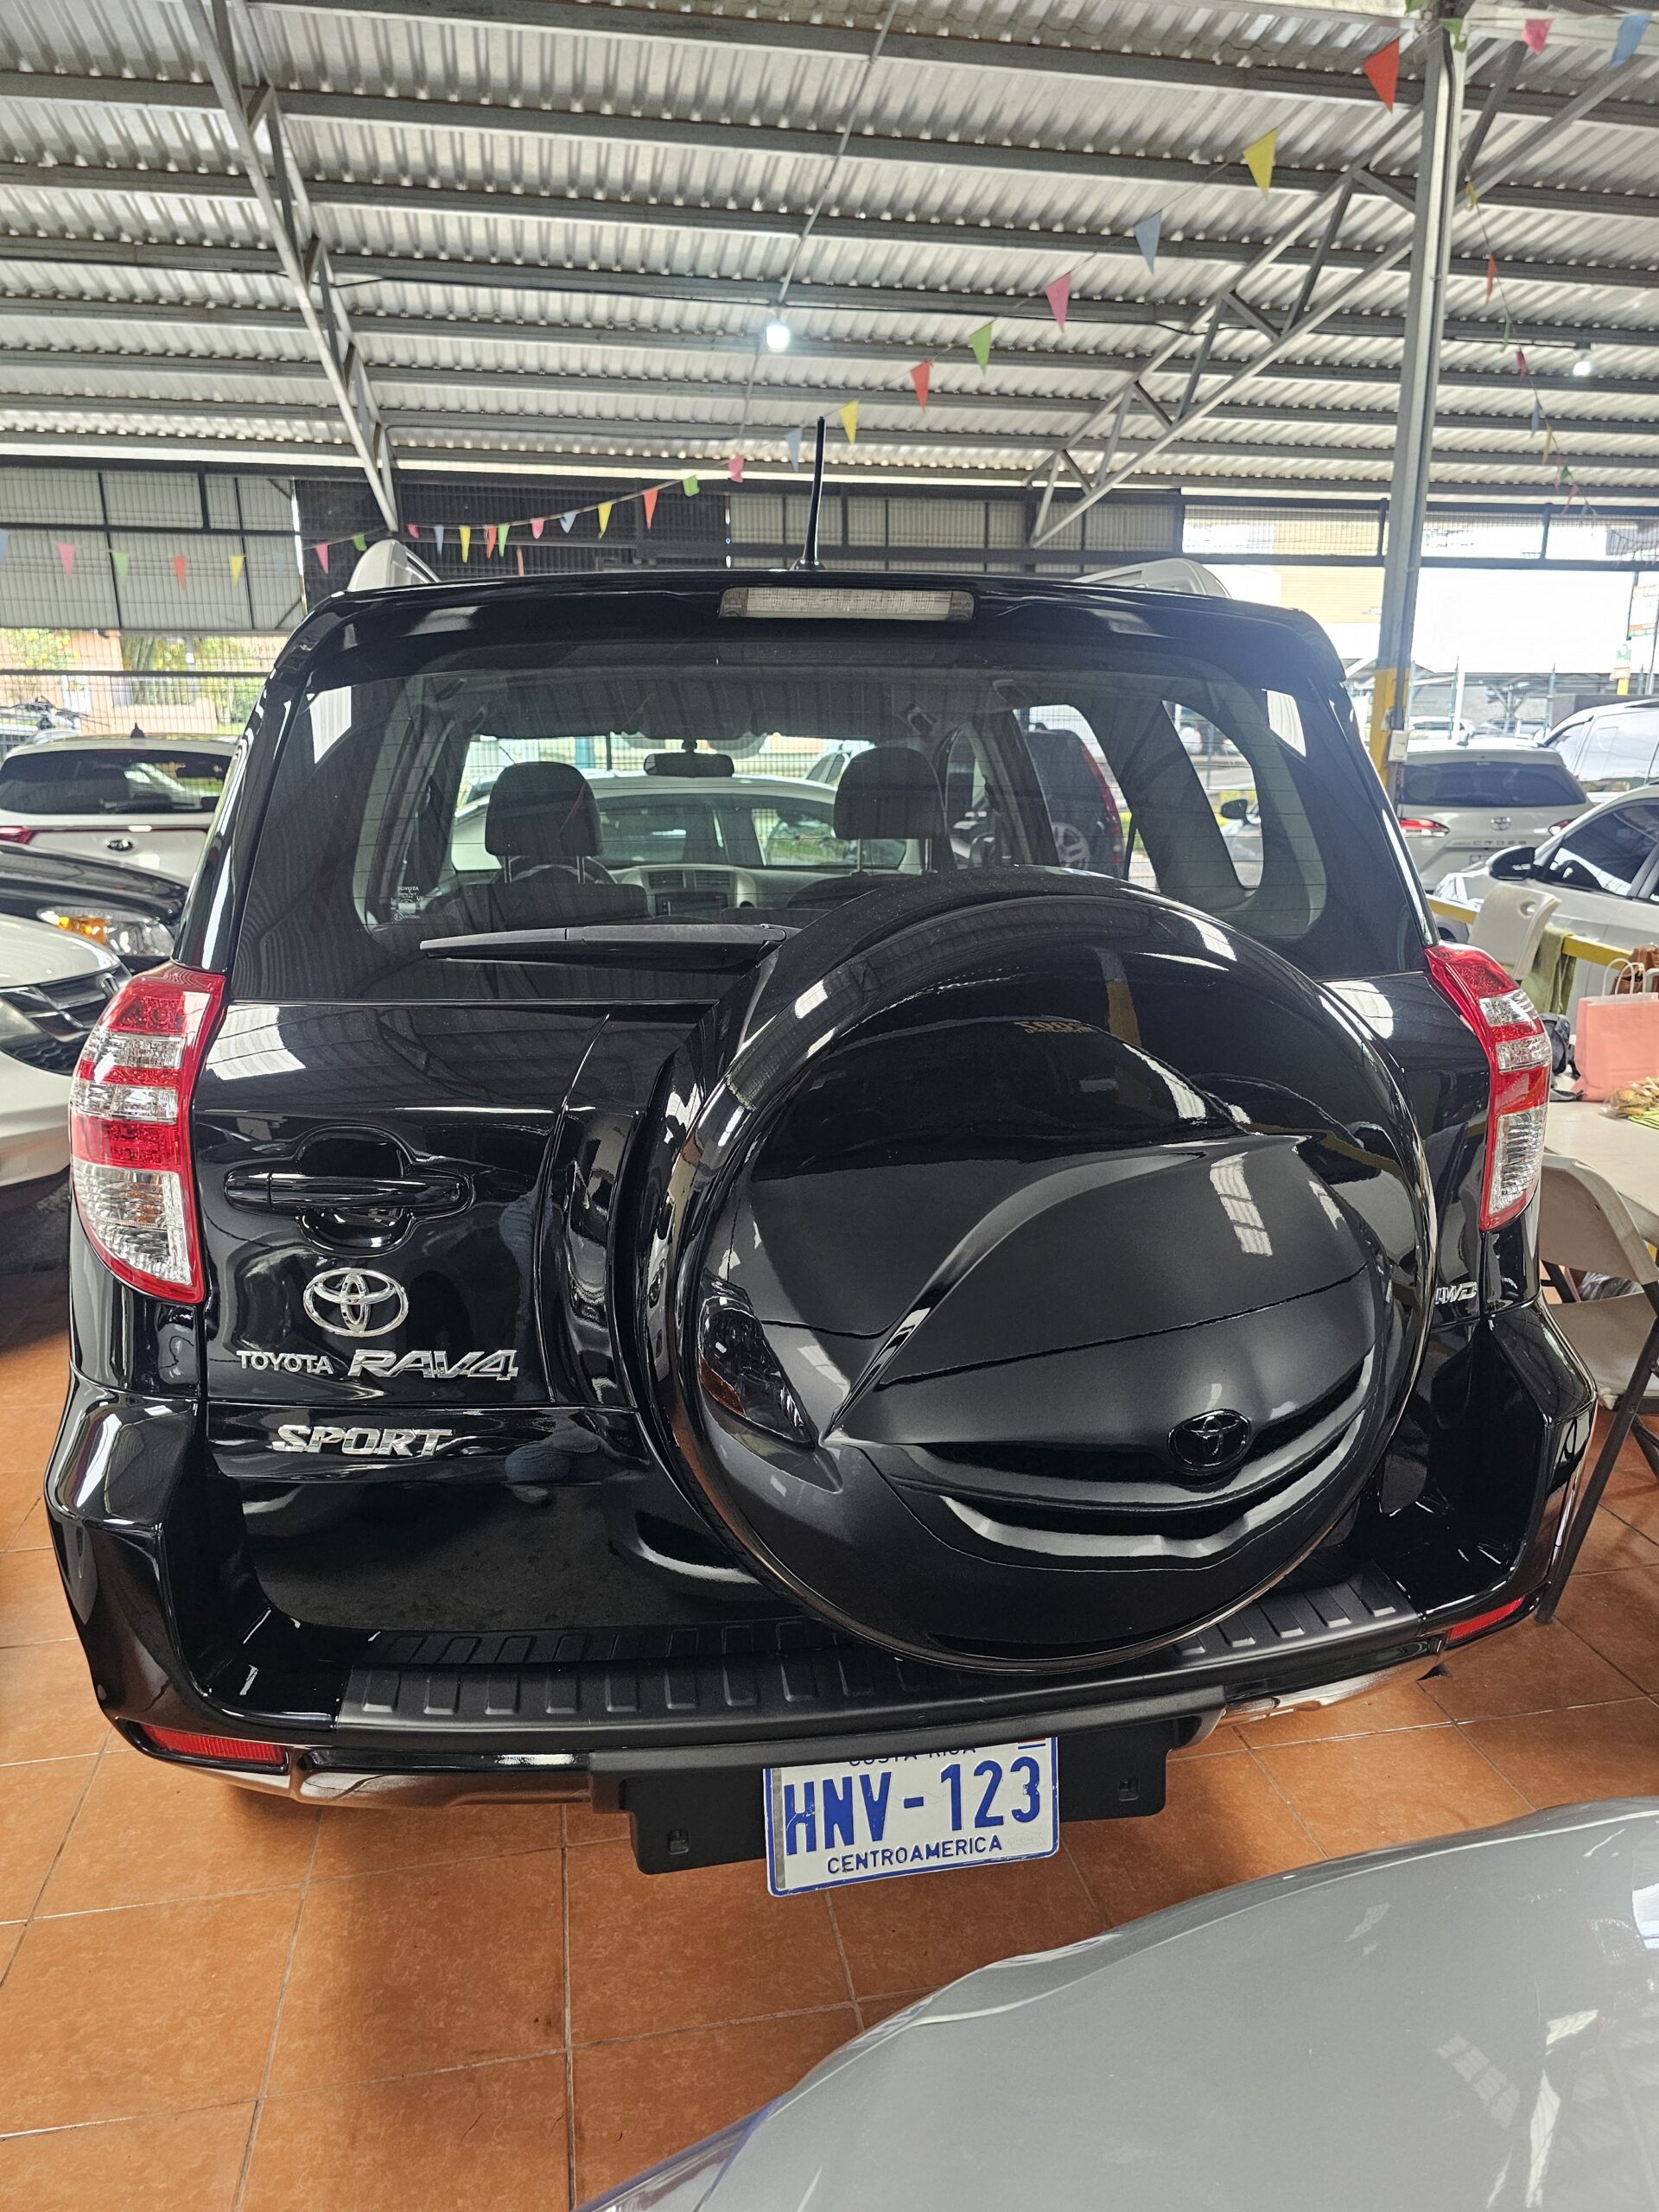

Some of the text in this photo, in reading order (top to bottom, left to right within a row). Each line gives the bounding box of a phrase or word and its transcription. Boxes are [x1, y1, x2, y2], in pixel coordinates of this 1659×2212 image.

[1434, 1281, 1478, 1304] AWD
[236, 1349, 518, 1381] TOYOTA RAV4
[266, 1424, 454, 1457] SPORT
[827, 1834, 1002, 1874] CENTROAMERICA
